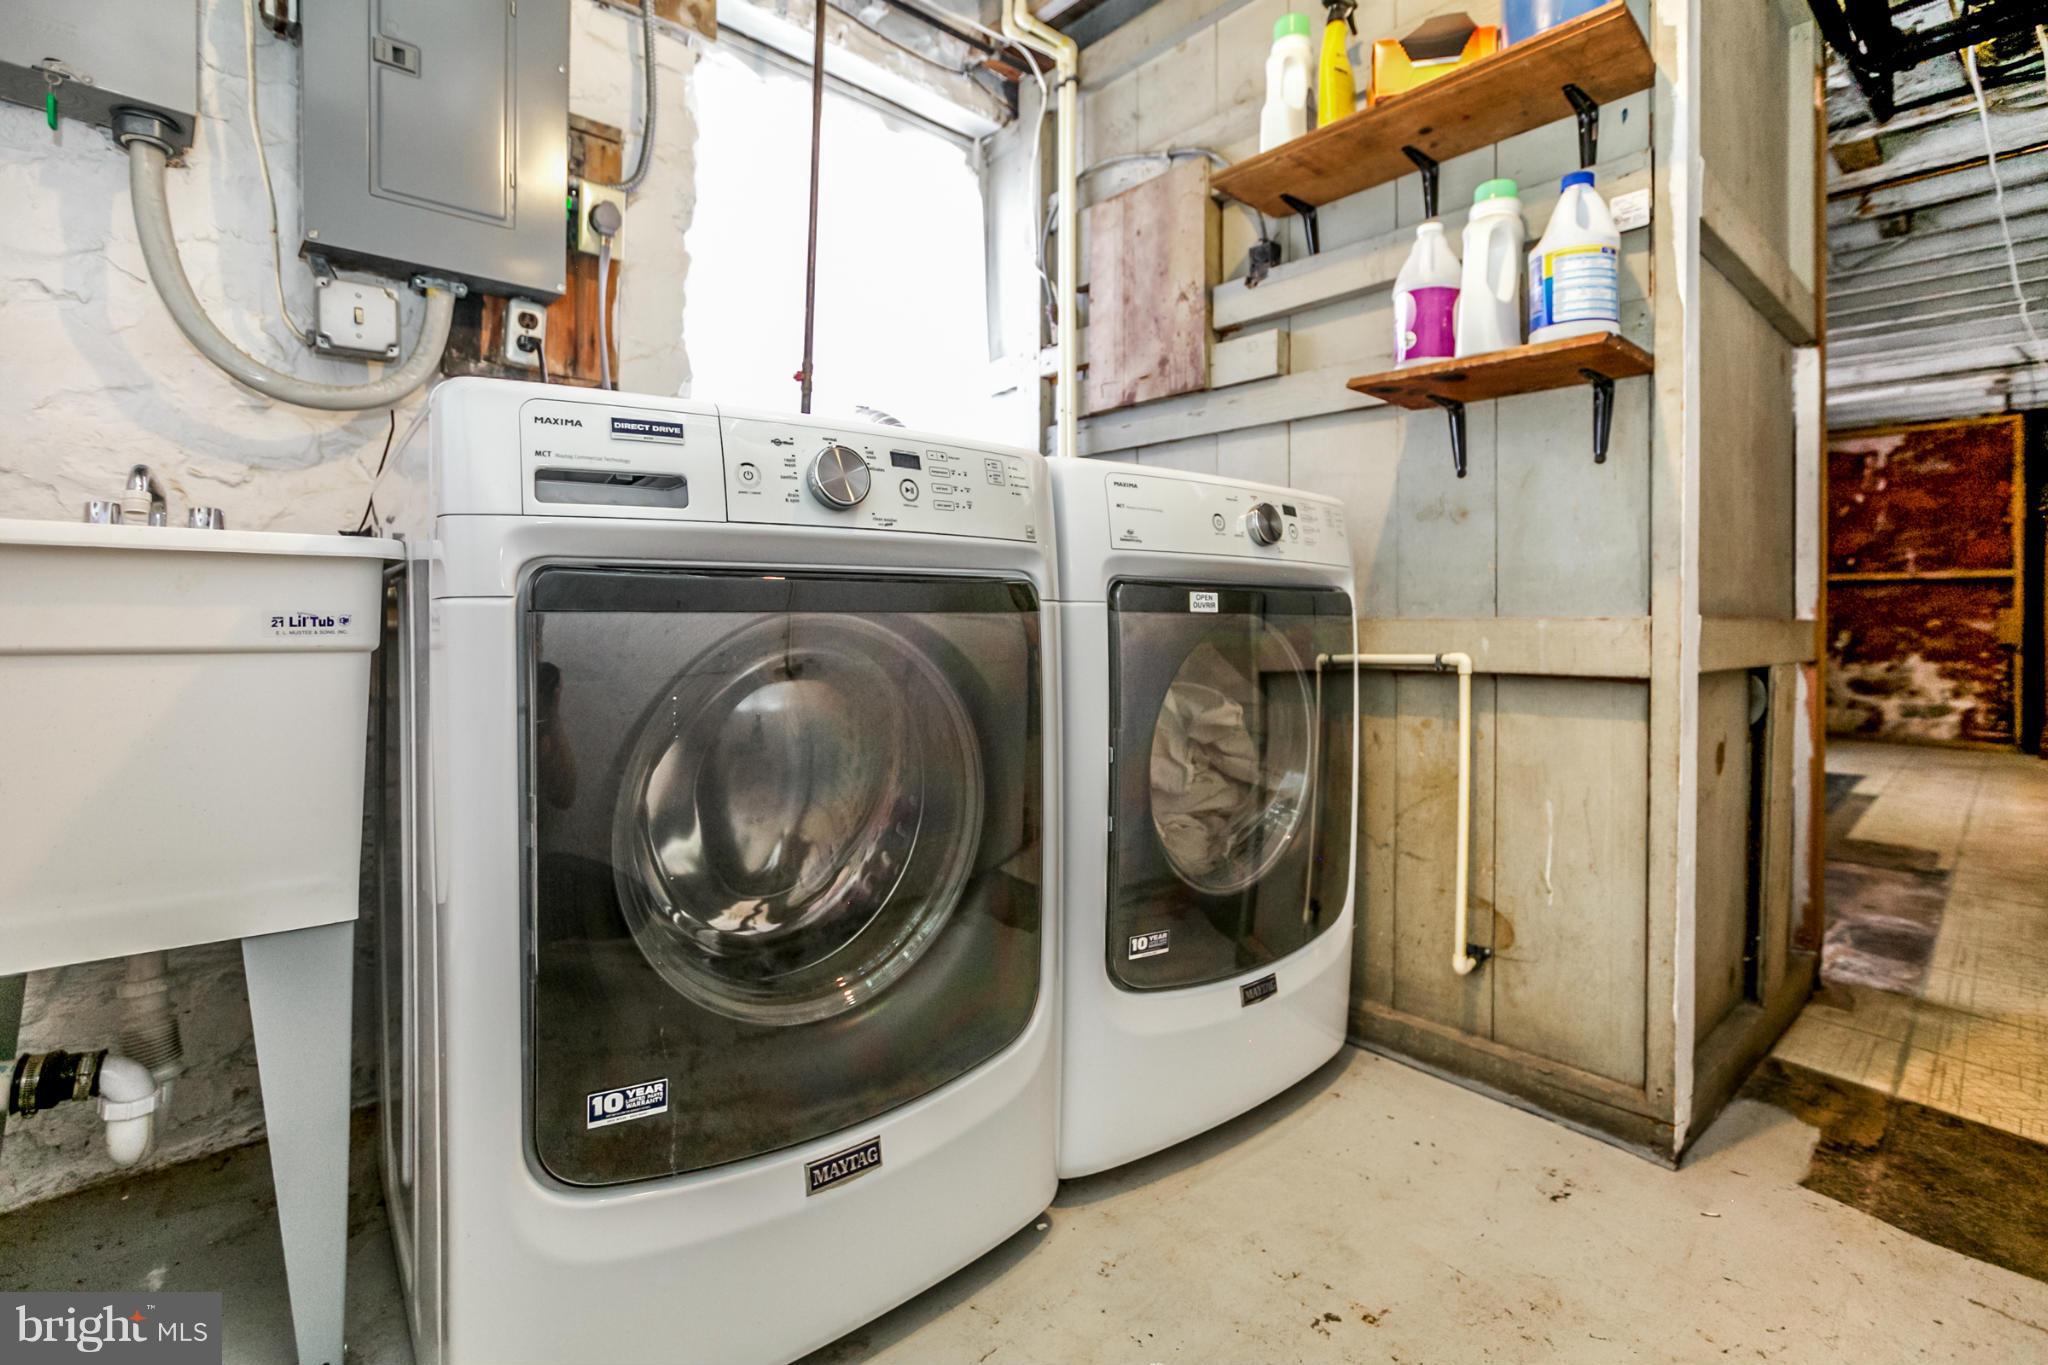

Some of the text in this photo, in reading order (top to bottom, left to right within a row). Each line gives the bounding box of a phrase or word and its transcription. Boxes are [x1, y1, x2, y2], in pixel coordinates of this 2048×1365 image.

[534, 416, 583, 428] MAXIMA
[613, 421, 681, 434] DIRECT DRIVE
[535, 450, 552, 458] MCT
[1113, 481, 1139, 489] MAXIMA
[1195, 593, 1213, 601] OPEN
[1193, 601, 1216, 609] OUVRIR
[1132, 936, 1148, 952] 10
[1149, 932, 1168, 941] YEAR
[592, 1092, 625, 1117] 10
[626, 1083, 664, 1098] YEAR
[625, 1096, 664, 1109] WARRANTY
[813, 1146, 879, 1186] MAYTAG
